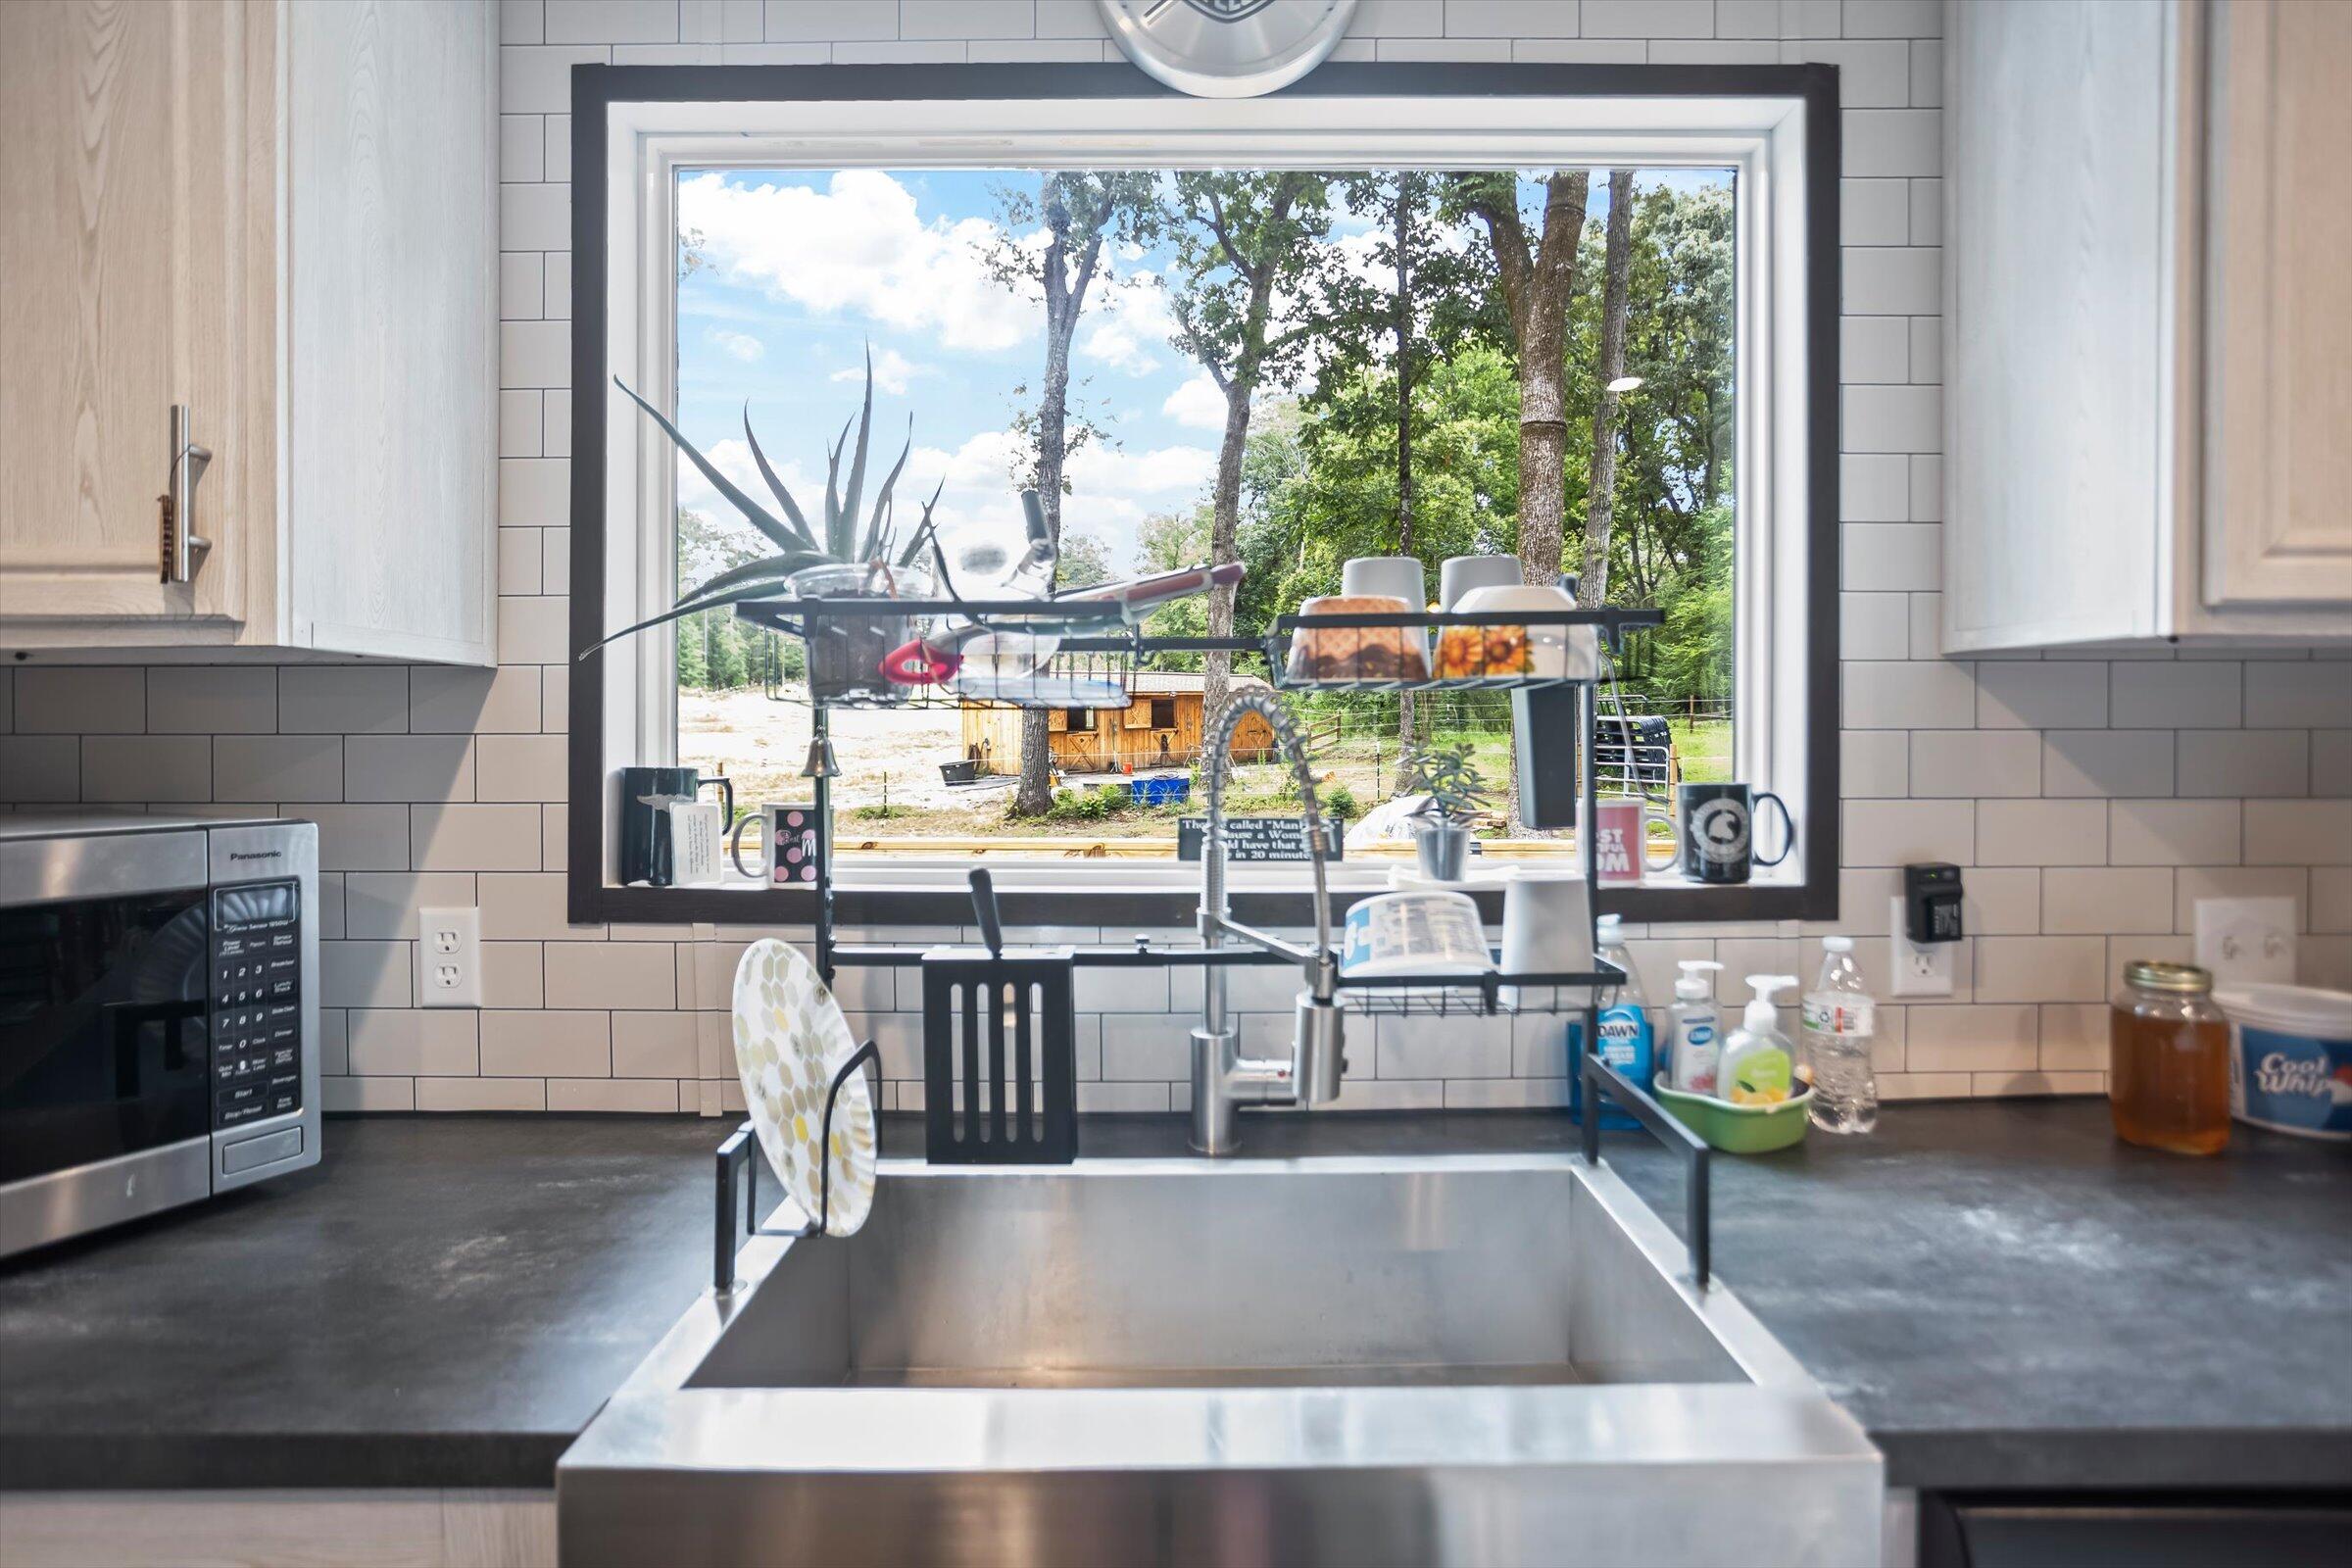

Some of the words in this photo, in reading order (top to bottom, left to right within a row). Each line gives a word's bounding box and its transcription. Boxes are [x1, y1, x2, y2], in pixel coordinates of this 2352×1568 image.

[1229, 820, 1263, 830] called
[1242, 840, 1269, 850] have
[1272, 840, 1296, 850] that
[230, 851, 281, 860] Panasonic
[222, 970, 228, 979] 1
[238, 967, 246, 977] 2
[255, 965, 263, 974] 3
[221, 994, 229, 1004] 4
[239, 991, 246, 1001] 5
[256, 988, 263, 998] 6
[222, 1018, 230, 1028] 7
[239, 1015, 247, 1025] 8
[256, 1012, 264, 1022] 9
[1597, 1025, 1639, 1037] DAWN
[239, 1039, 247, 1049] 0
[2261, 1052, 2326, 1074] Cool
[2253, 1069, 2329, 1097] Whip
